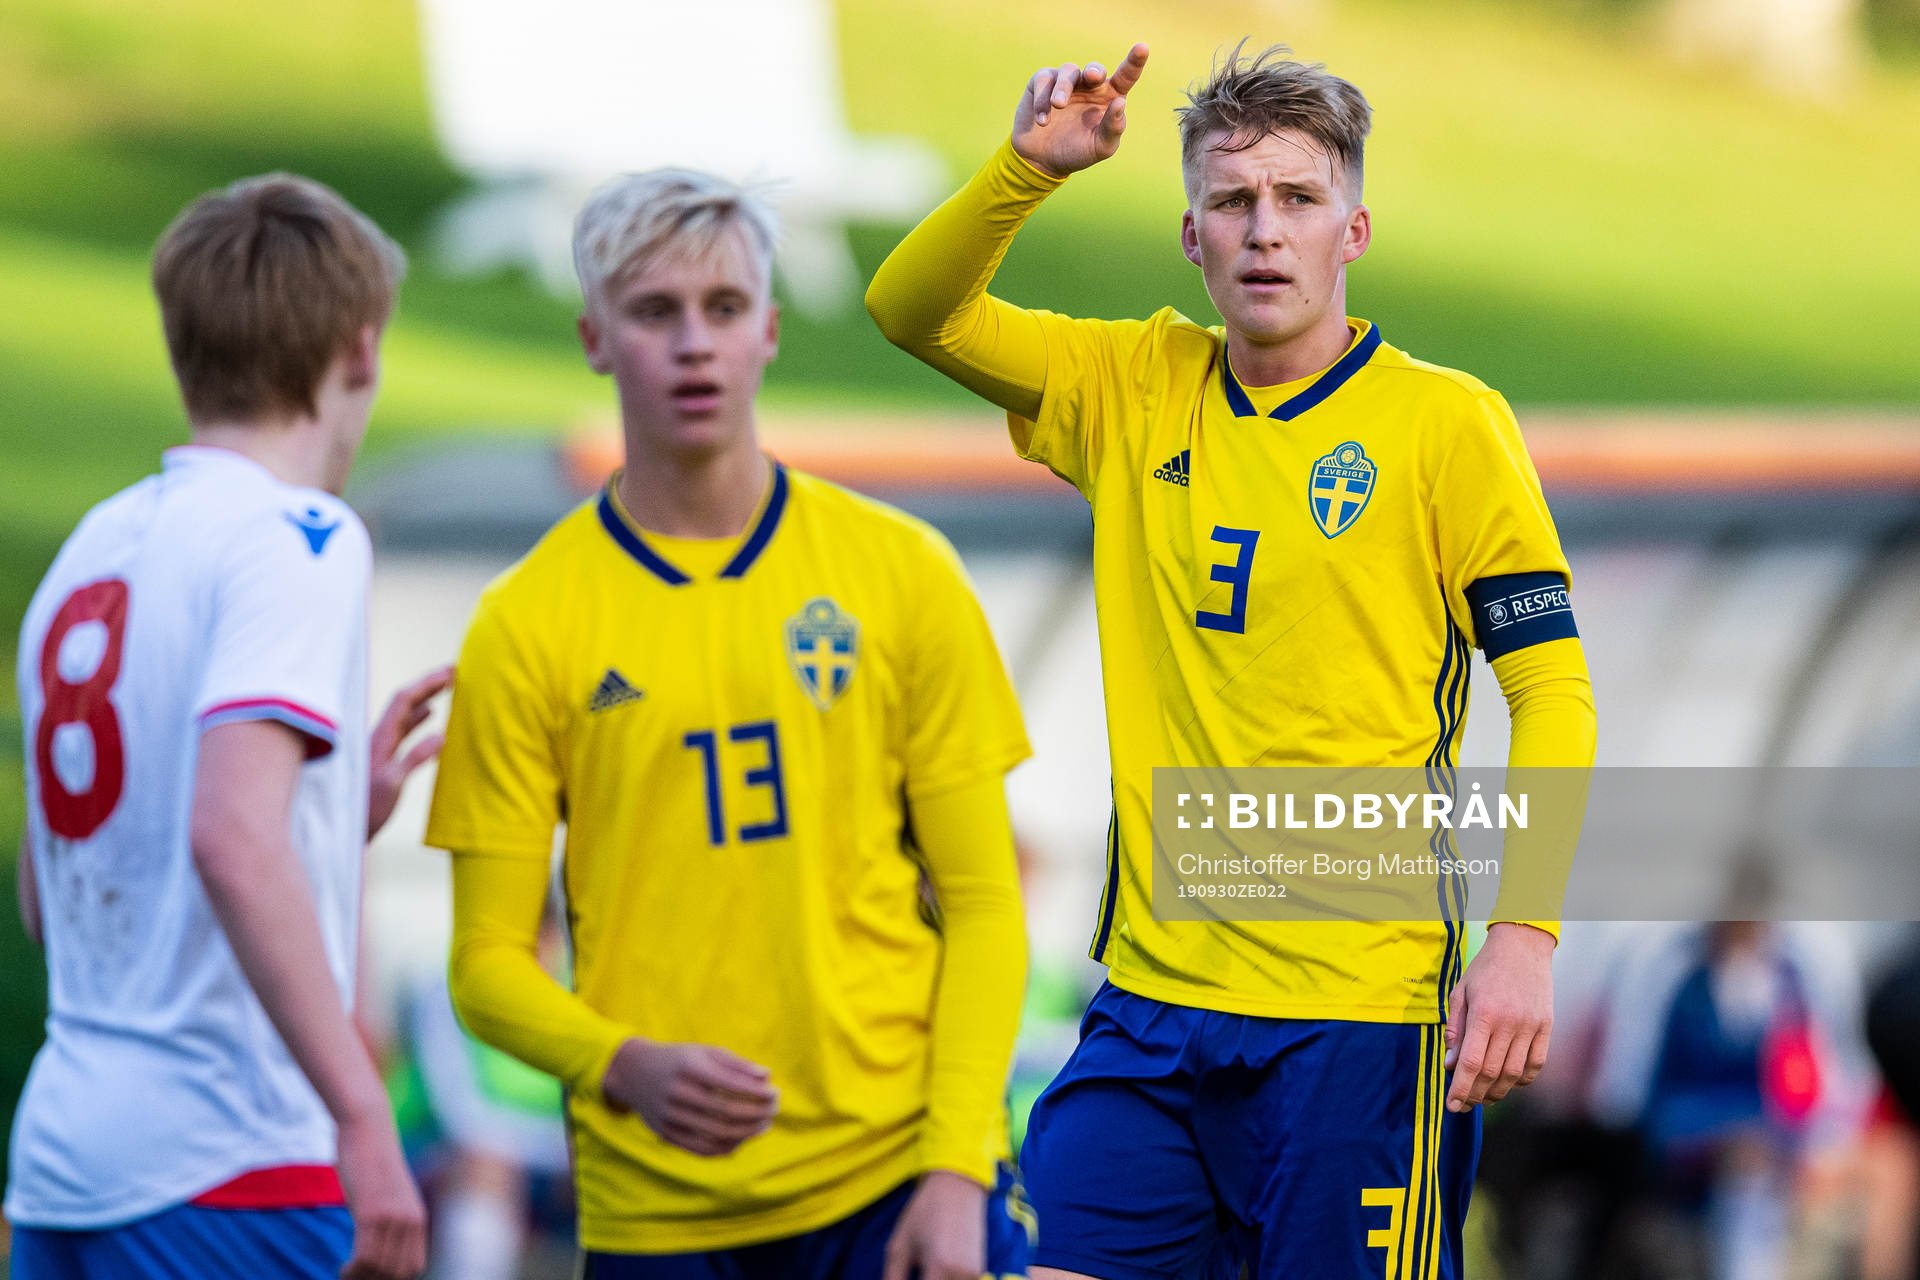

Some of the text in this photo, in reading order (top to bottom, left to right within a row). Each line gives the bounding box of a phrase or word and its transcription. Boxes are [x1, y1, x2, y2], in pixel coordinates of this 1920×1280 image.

[1153, 468, 1190, 489] adida
[1323, 467, 1365, 479] SVERIGE
[1195, 525, 1260, 634] 3
[36, 577, 129, 841] 8
[682, 718, 790, 847] 13
